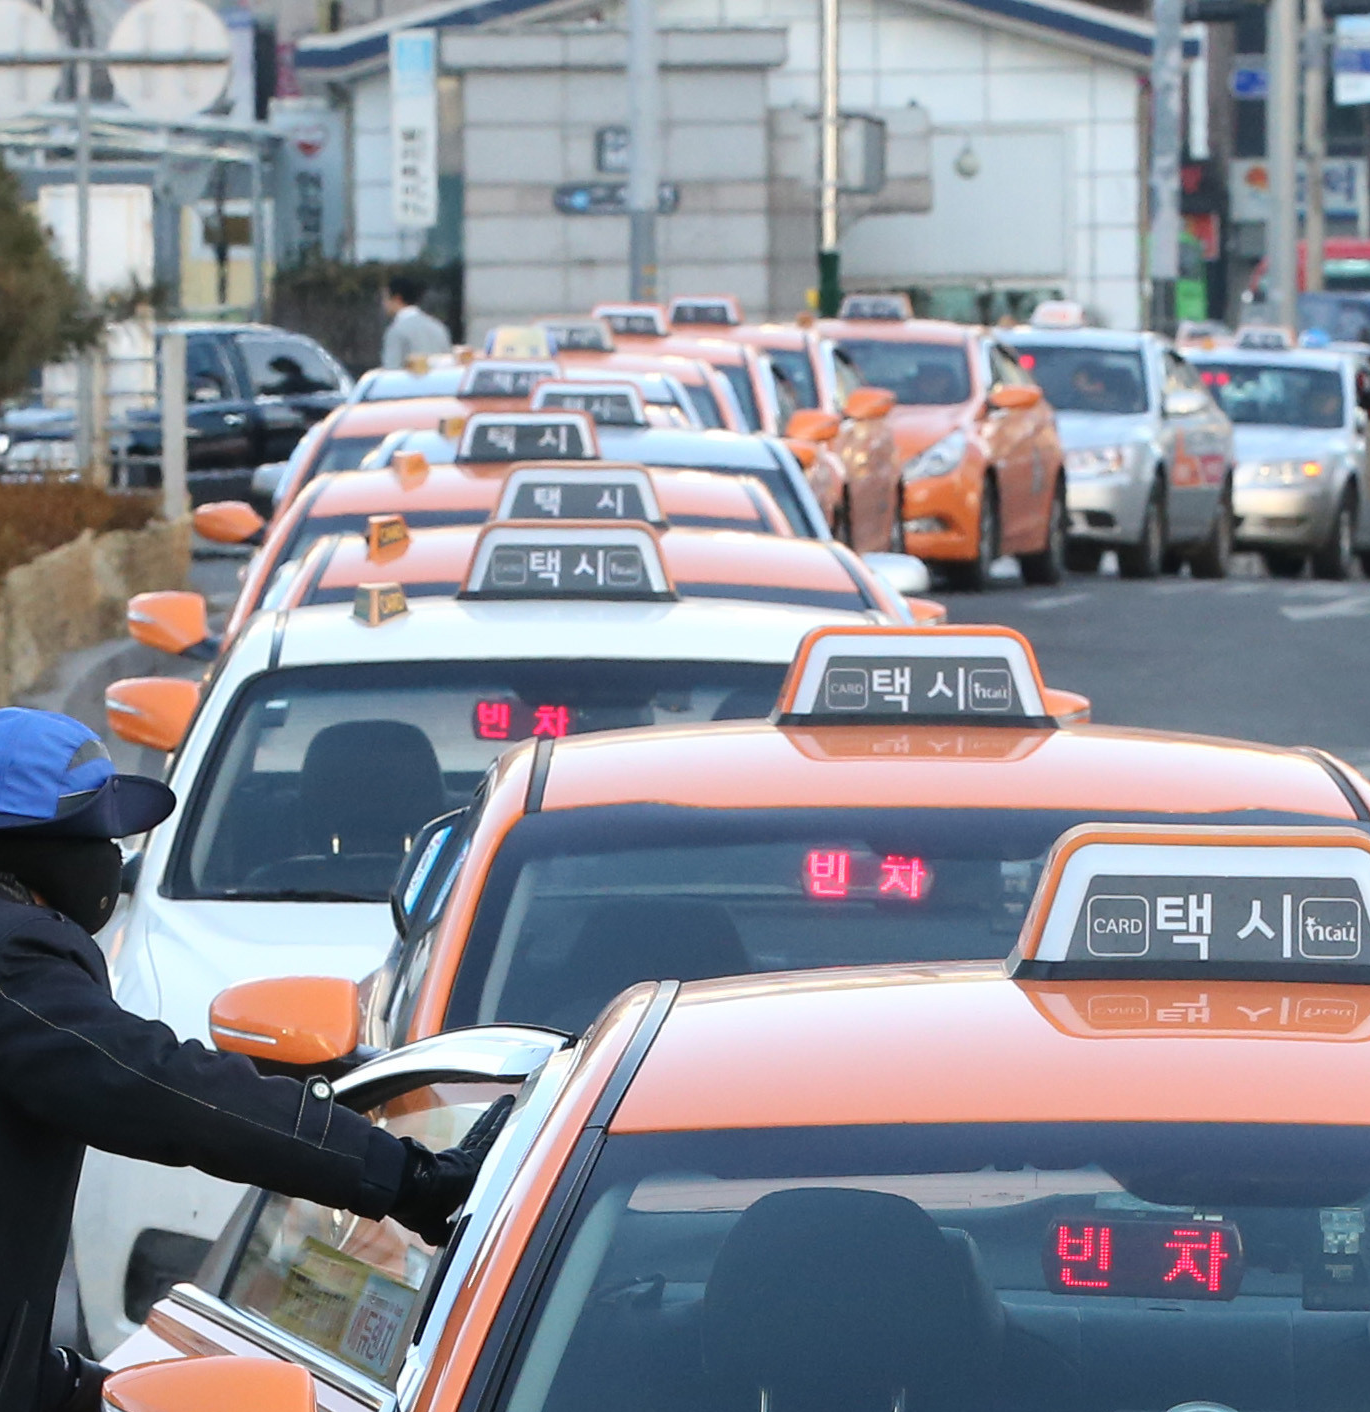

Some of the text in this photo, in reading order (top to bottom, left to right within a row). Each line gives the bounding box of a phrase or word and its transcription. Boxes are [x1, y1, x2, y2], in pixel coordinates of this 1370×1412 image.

[533, 486, 624, 517] 택시
[530, 549, 605, 588] 택시
[831, 683, 865, 696] CARD
[872, 667, 966, 712] 택시
[1093, 917, 1143, 935] CARD
[1155, 892, 1293, 961] 택시
